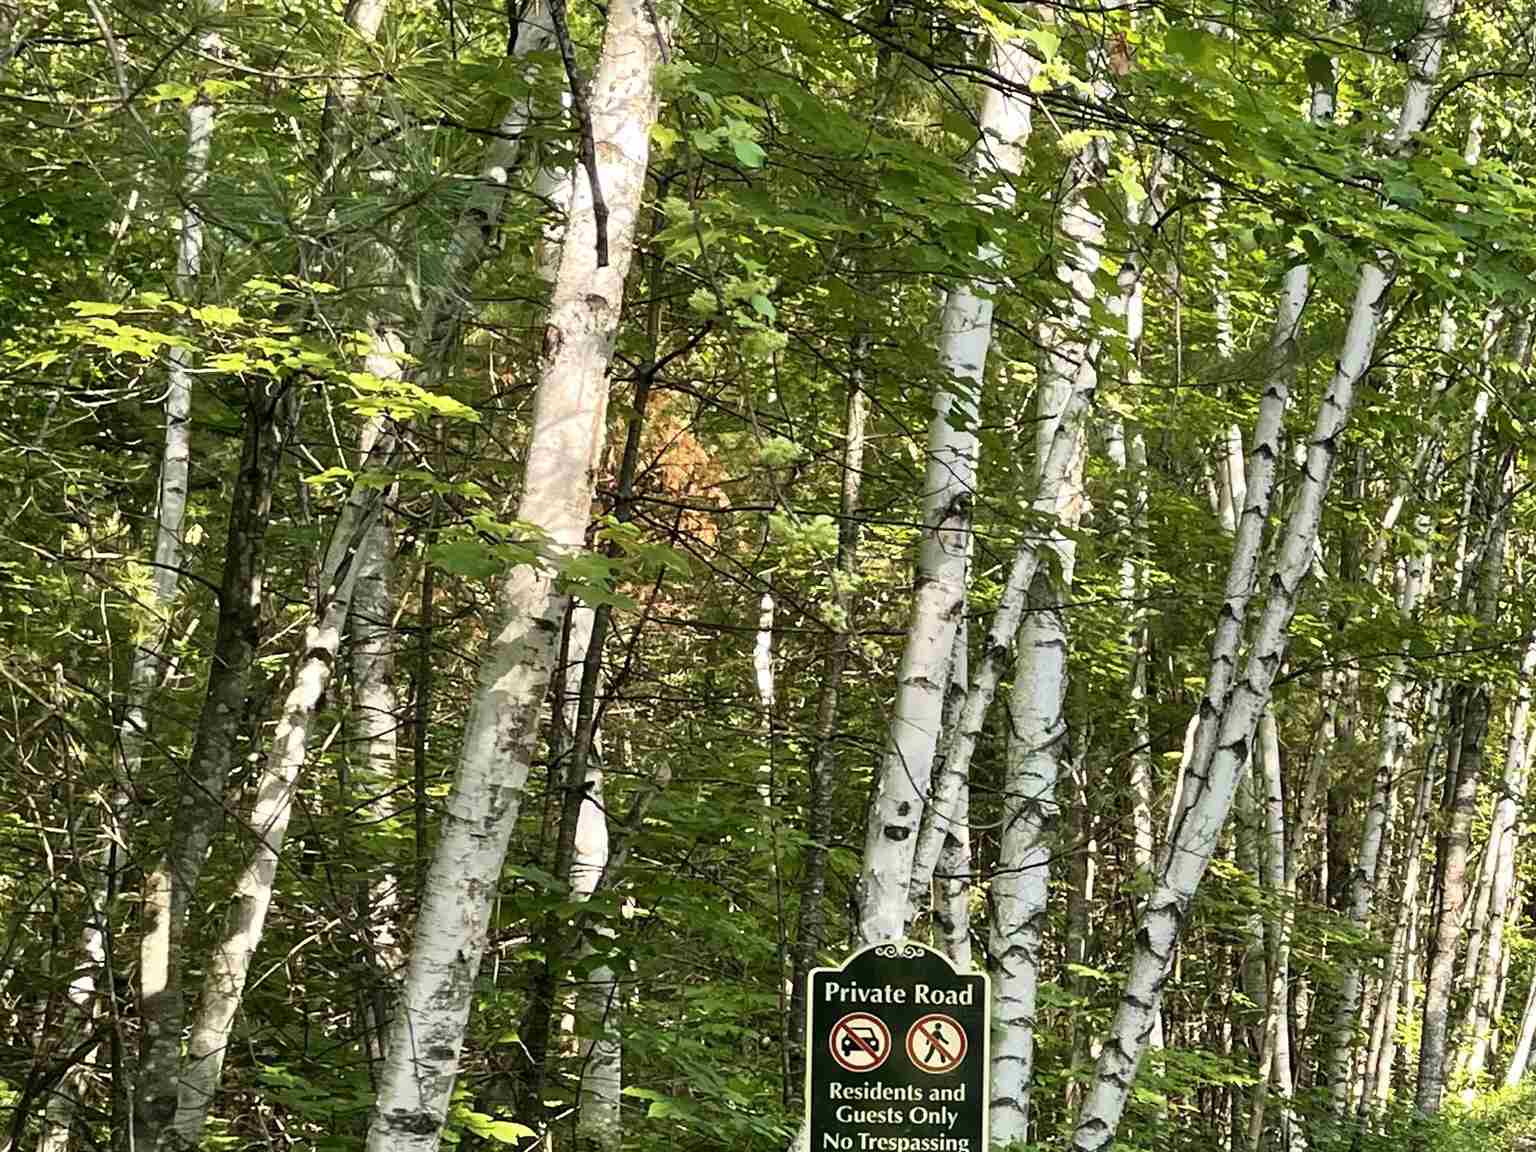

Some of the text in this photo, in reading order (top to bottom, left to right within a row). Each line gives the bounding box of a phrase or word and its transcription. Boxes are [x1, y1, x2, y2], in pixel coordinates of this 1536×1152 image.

[824, 981, 973, 1006] Private Road
[829, 1082, 966, 1102] Residents and
[835, 1106, 958, 1129] Guests Only
[823, 1132, 853, 1150] No
